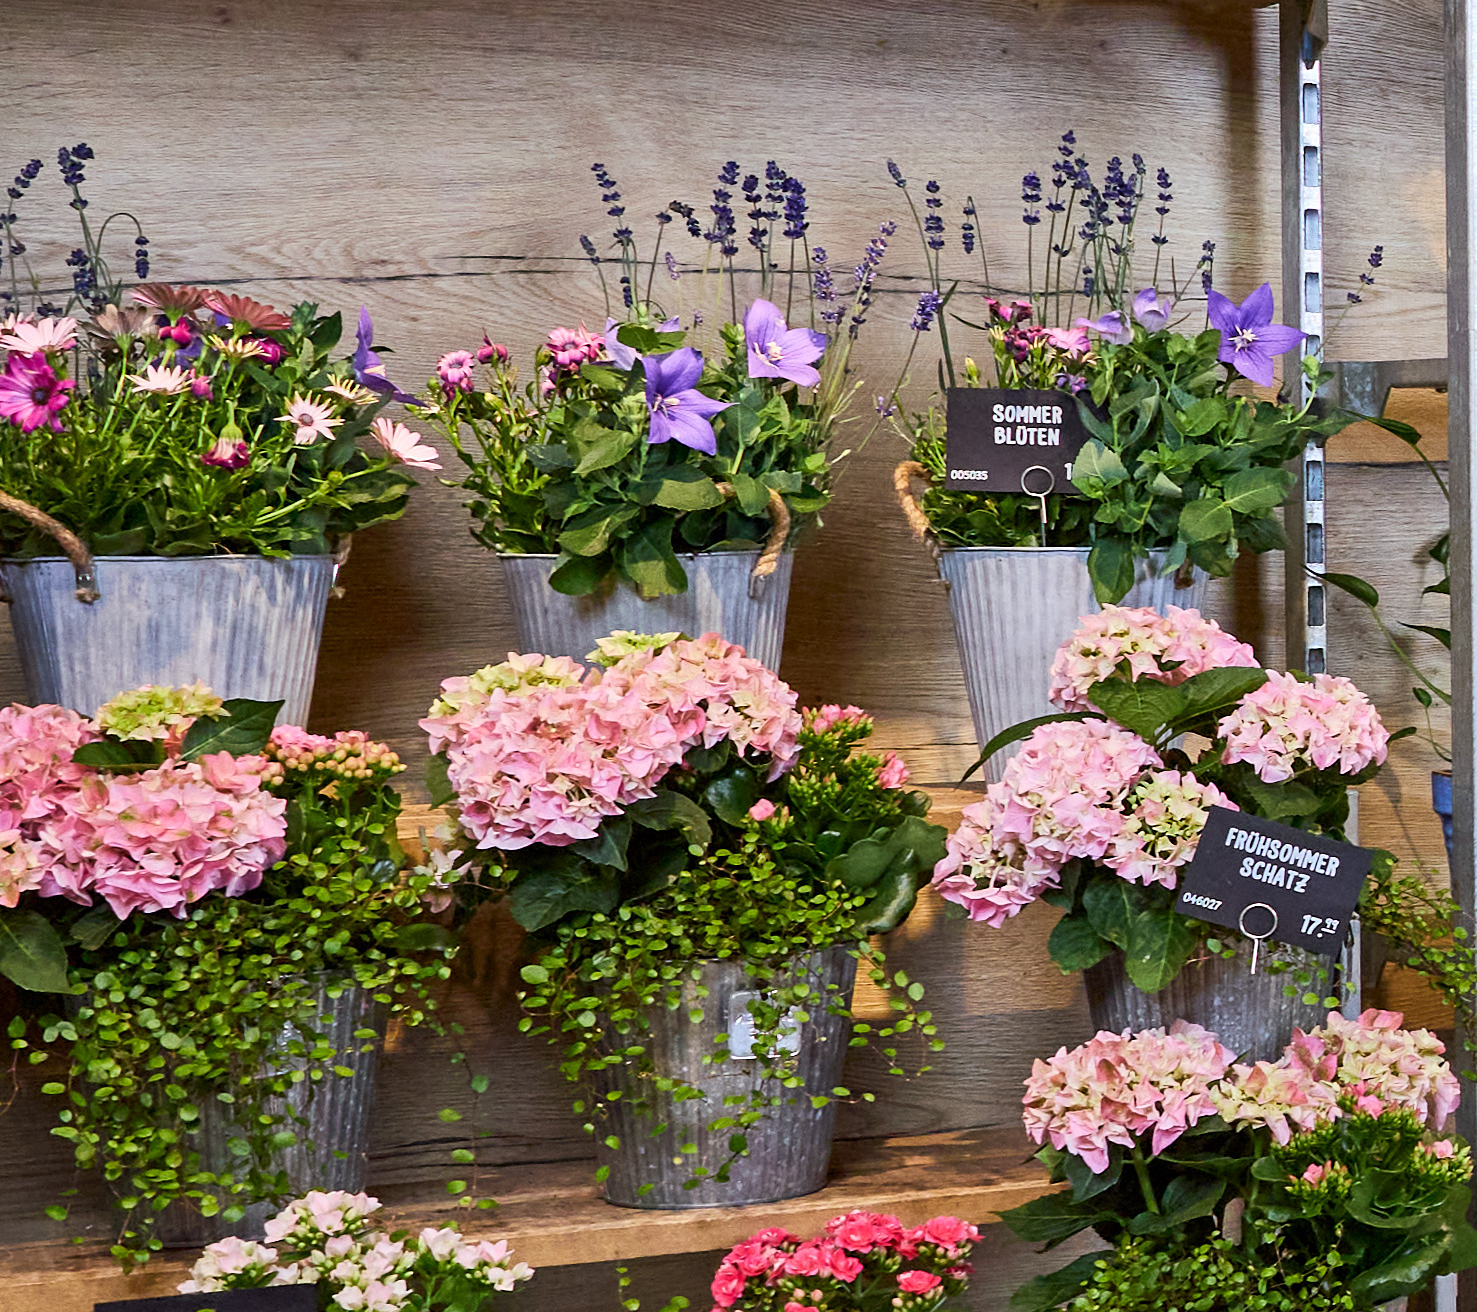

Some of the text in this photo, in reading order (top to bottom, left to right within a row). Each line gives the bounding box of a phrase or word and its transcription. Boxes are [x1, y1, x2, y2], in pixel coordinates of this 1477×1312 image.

[992, 404, 1063, 425] SOMMER
[994, 426, 1060, 446] BLÜTEN
[1225, 827, 1340, 877] FRÜHSOMMER
[1240, 857, 1310, 893] SCHATZ
[1182, 892, 1222, 910] 046027
